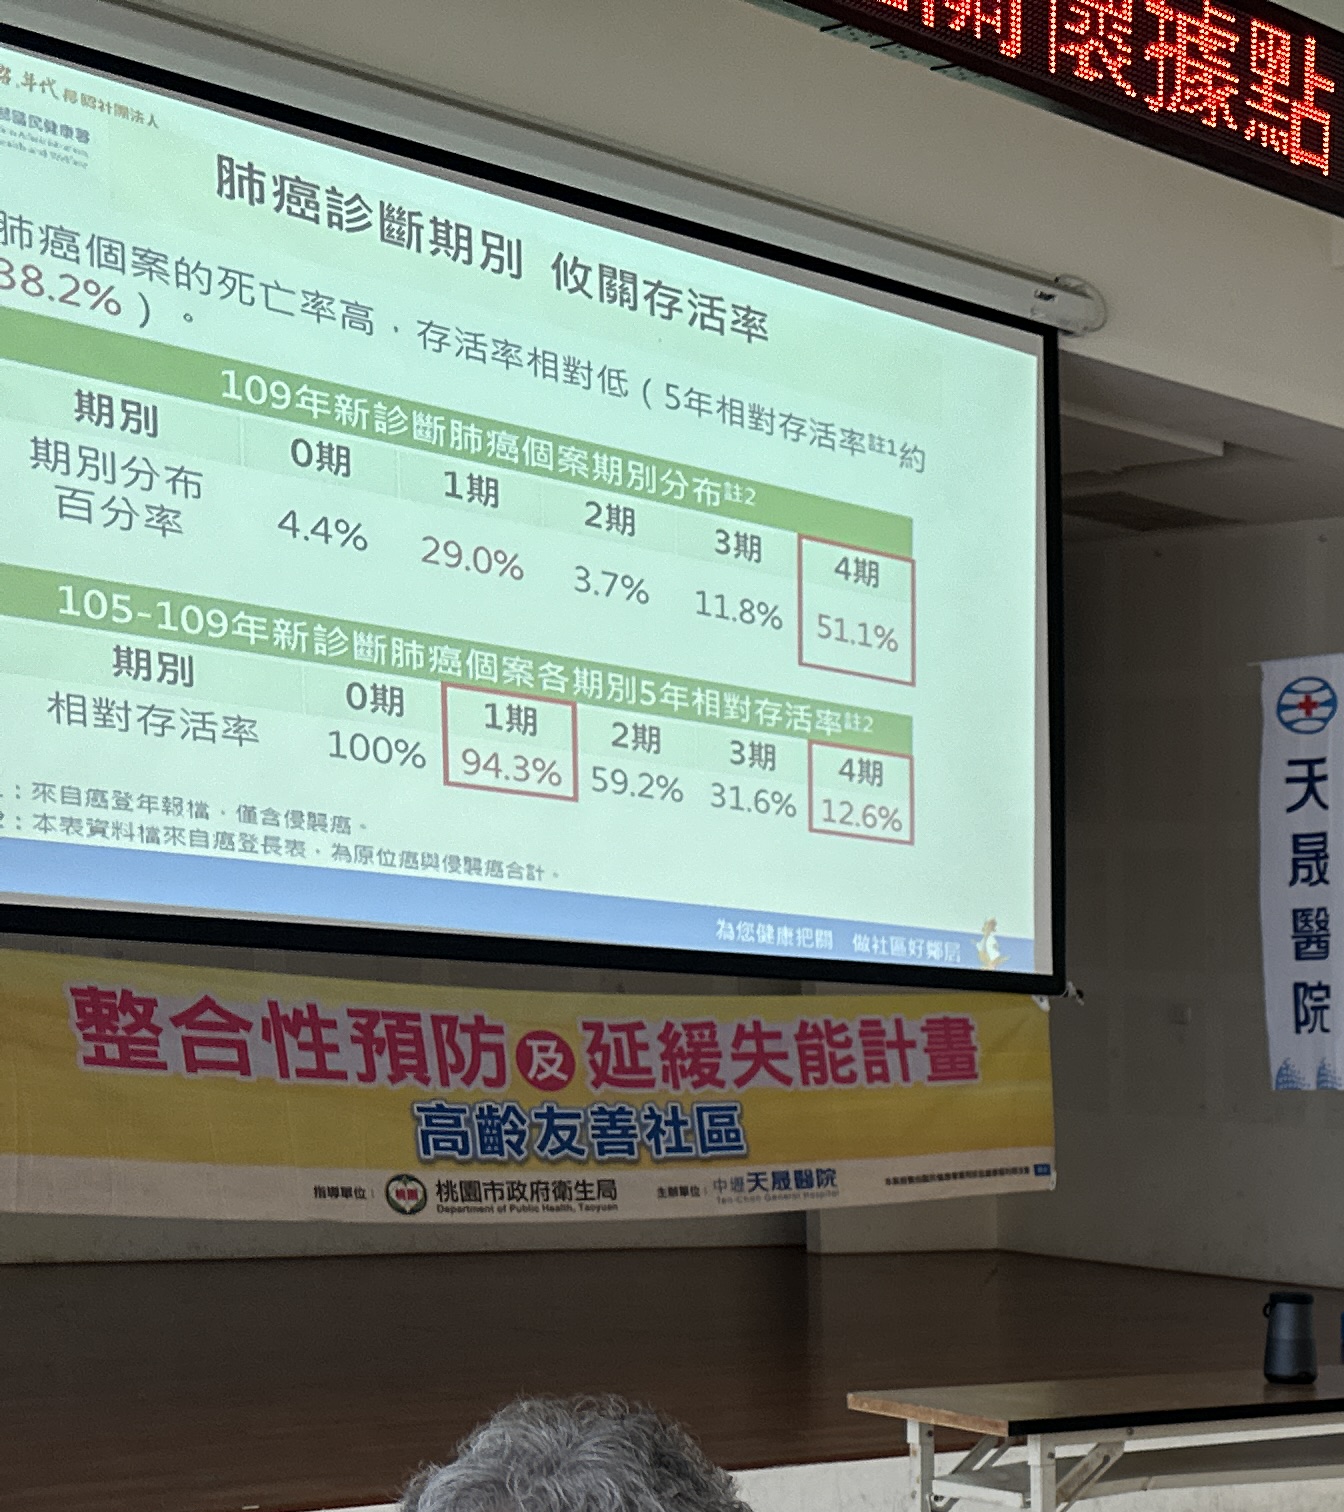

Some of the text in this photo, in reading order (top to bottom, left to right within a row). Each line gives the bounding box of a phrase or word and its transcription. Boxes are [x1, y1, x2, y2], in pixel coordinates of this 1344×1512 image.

[877, 0, 1335, 176] 懷據點
[216, 153, 769, 344] 肺癌診斷期別 攸關存活率
[29, 435, 204, 499] 期別分布
[74, 388, 880, 588] 期別 0期 1期 2期 3期 4期
[54, 484, 899, 653] 百分率 4.4% 29.0% 3.7% 11.8% 51.1%
[47, 690, 903, 832] 相對存活率 100% 94.3% 59.2% 31.6% 12.6%
[112, 645, 883, 787] 期別 0期 1期 2期 3期 4期
[1285, 756, 1332, 1034] 天晟醫院
[67, 982, 981, 1093] 整合性預防及延緩失能計畫
[414, 1099, 748, 1163] 高齡友善社區
[435, 1179, 618, 1203] 桃園市政府衛生局
